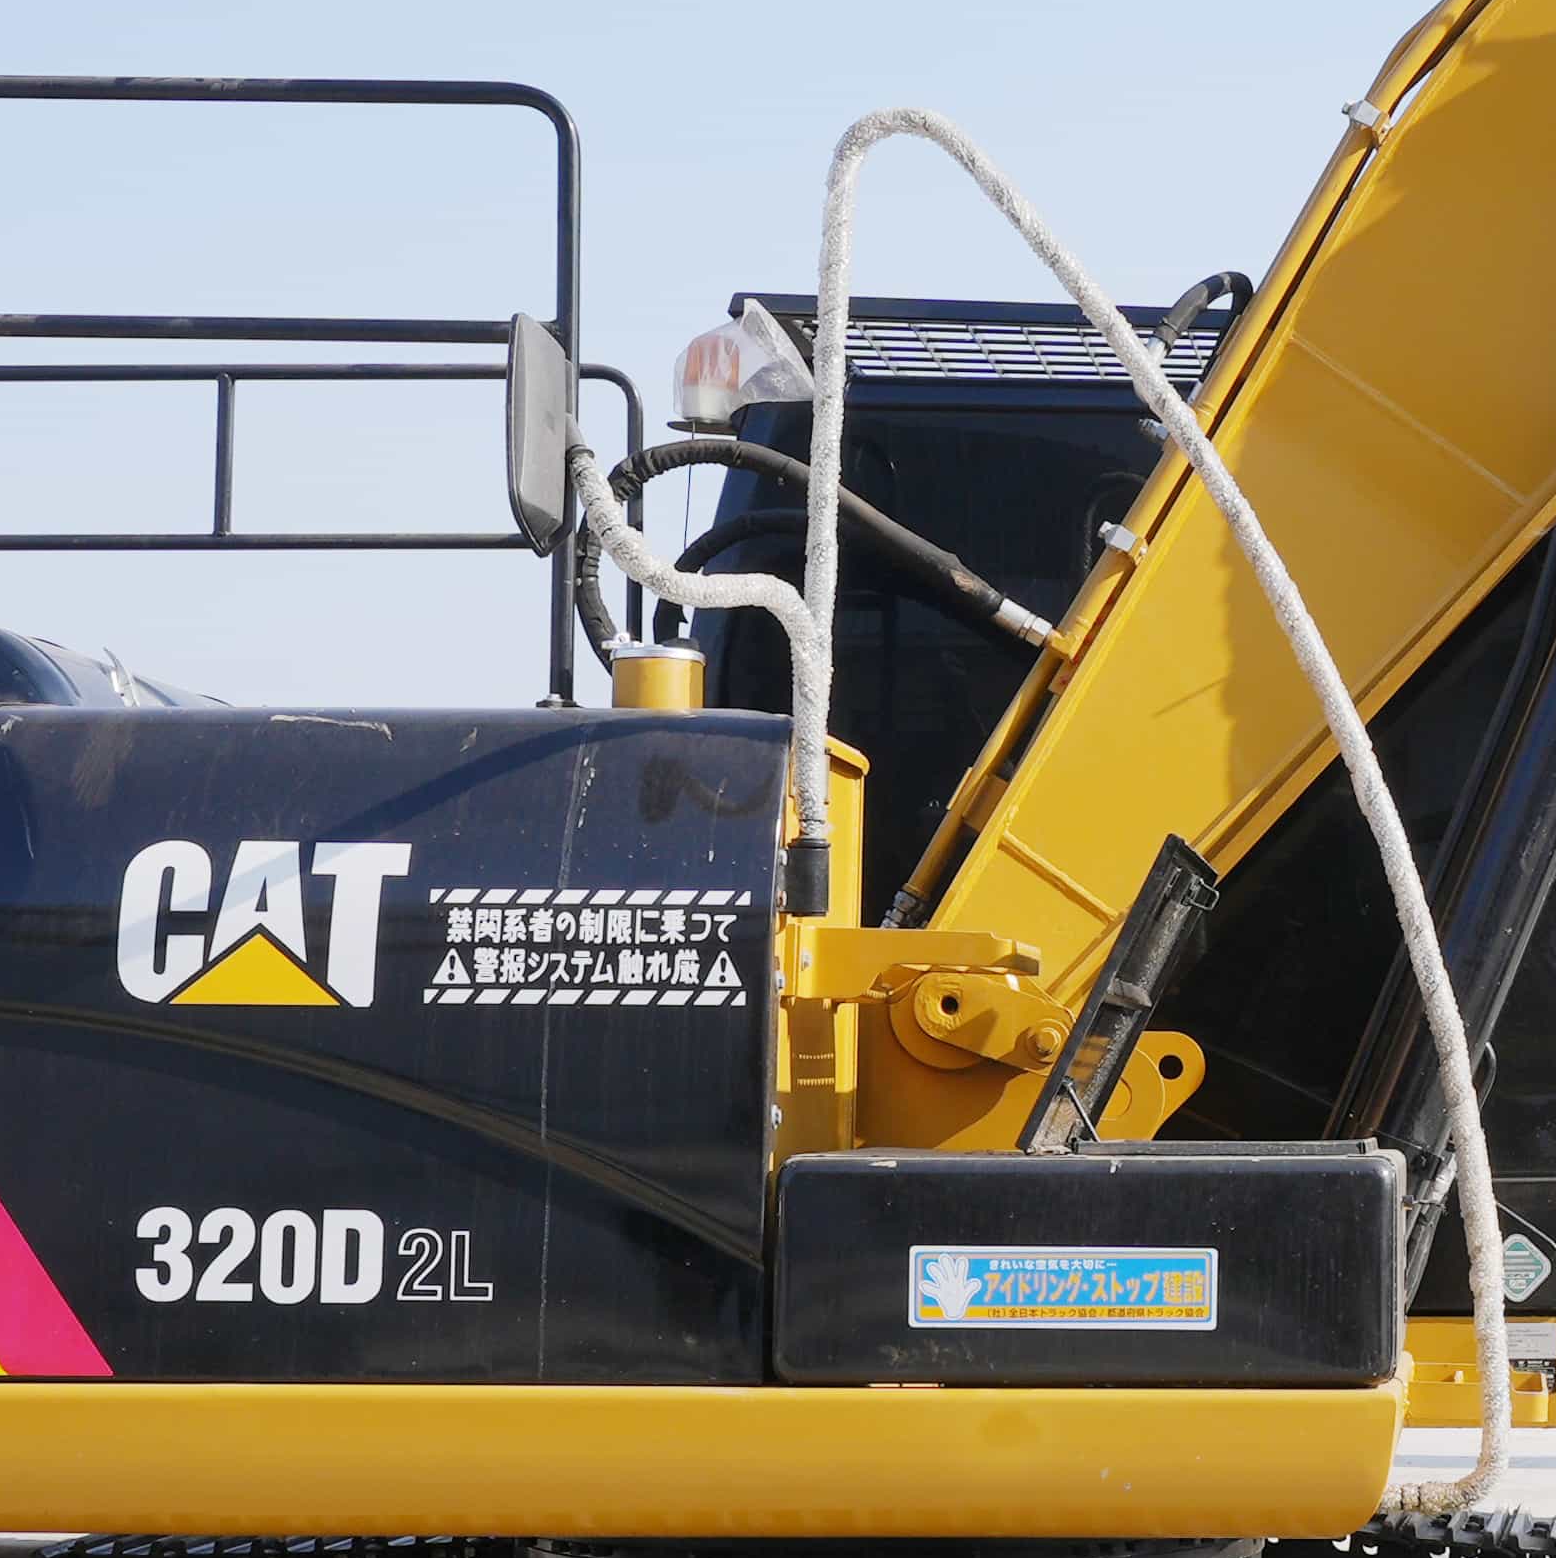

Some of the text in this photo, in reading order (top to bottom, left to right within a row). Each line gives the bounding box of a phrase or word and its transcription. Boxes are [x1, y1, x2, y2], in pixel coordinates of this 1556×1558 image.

[116, 839, 413, 1008] CAT
[135, 1206, 494, 1305] 320D 2L
